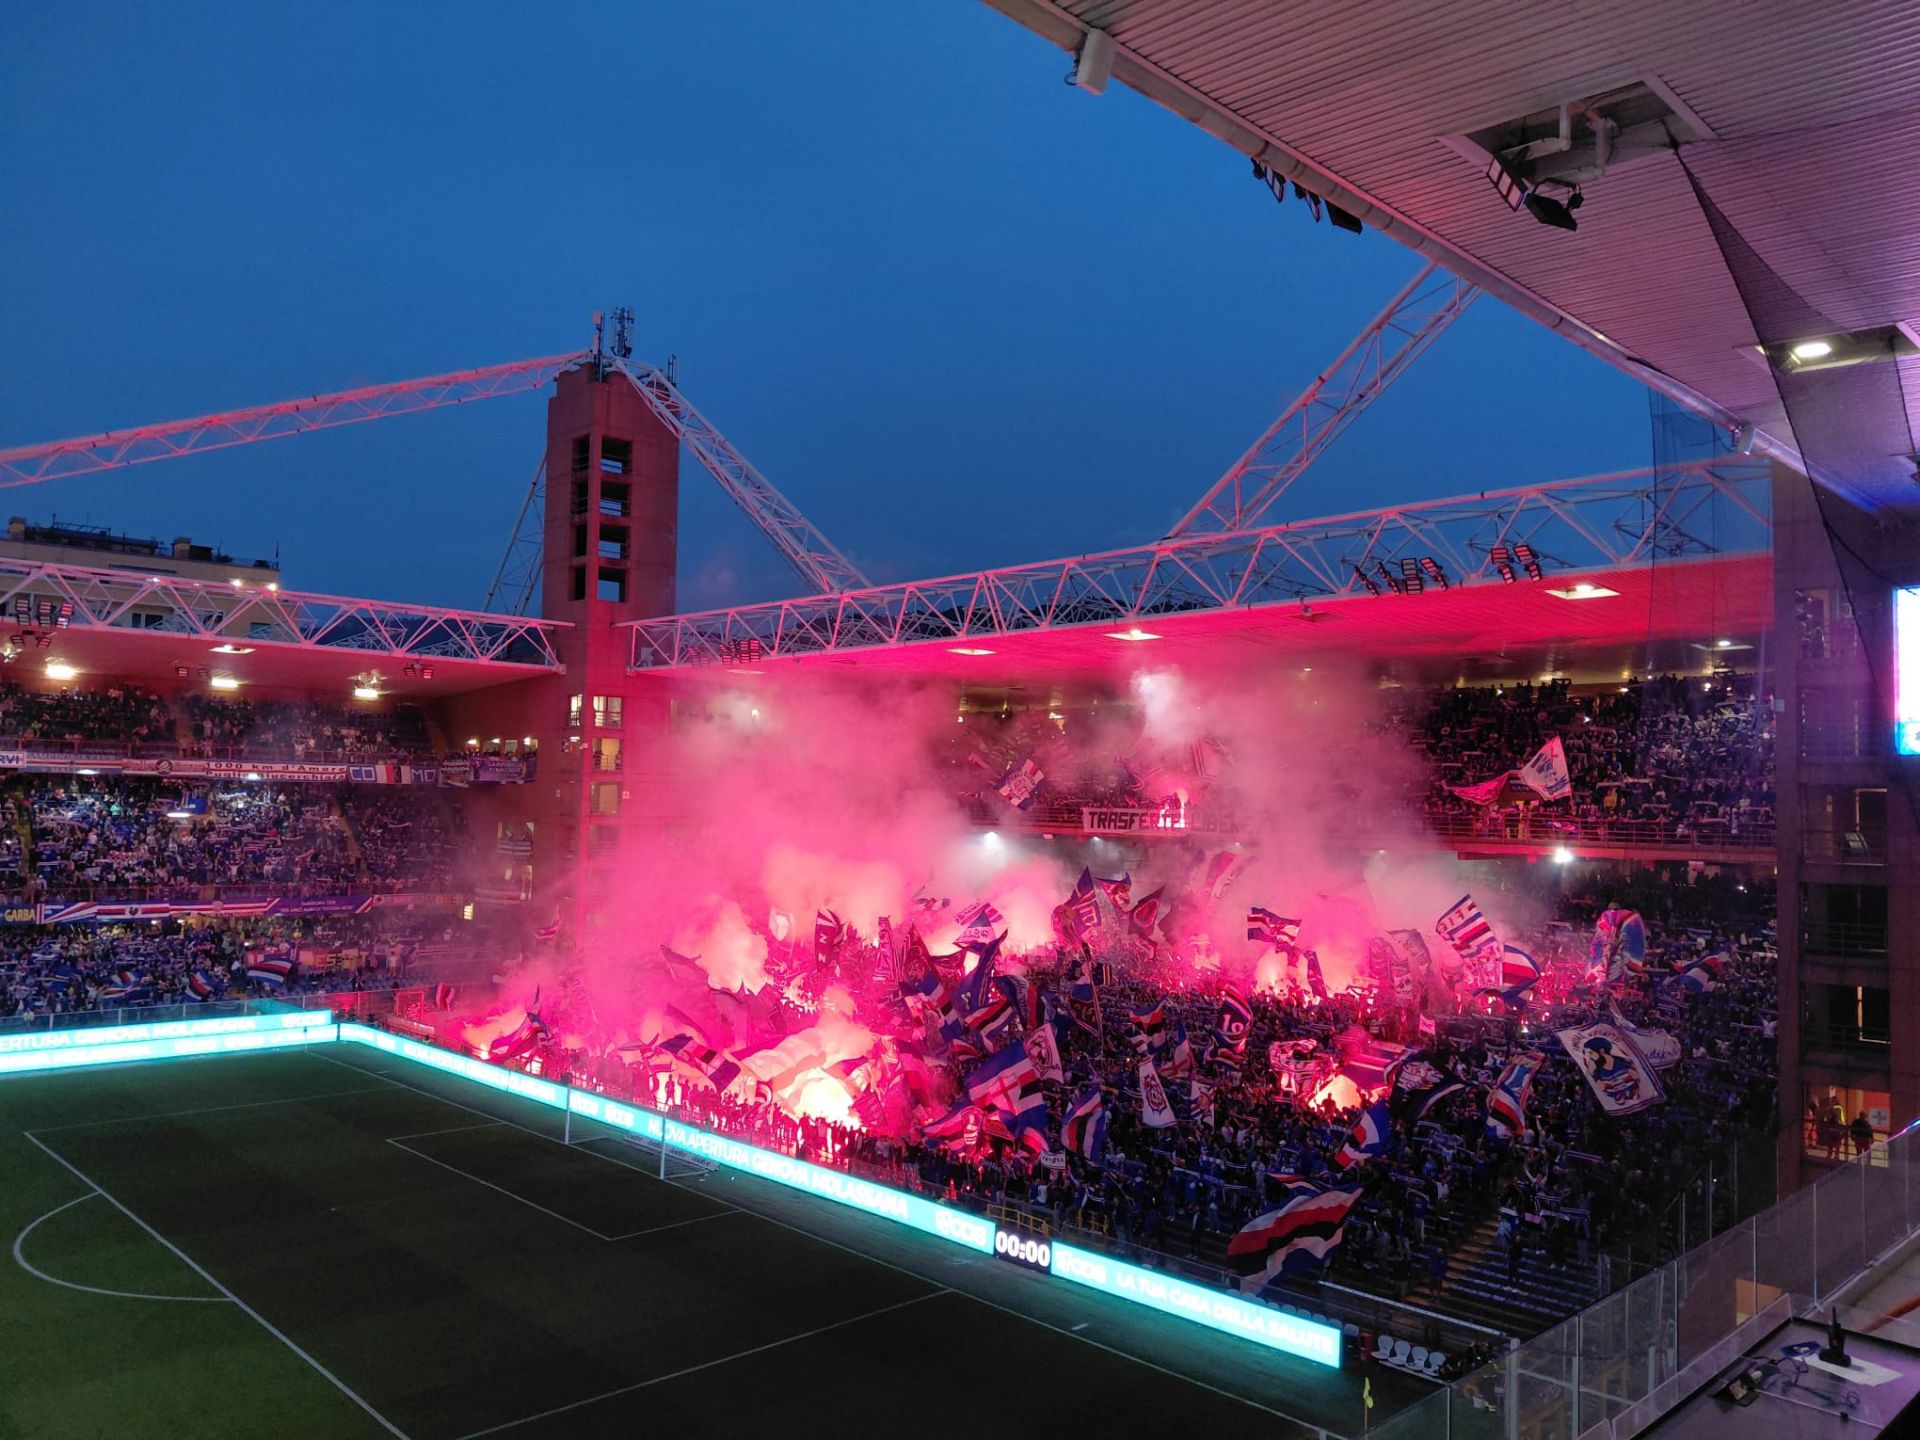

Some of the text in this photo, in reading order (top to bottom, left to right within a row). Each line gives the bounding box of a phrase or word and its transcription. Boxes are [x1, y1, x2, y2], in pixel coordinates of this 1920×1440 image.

[4, 908, 36, 922] GARBA
[686, 1129, 751, 1169] APERTURA
[751, 1151, 809, 1186] GENOVA
[811, 1173, 910, 1219] MOLASSANA
[995, 1230, 1051, 1268] 00:00
[1116, 1270, 1136, 1292] LA
[1136, 1277, 1168, 1303] TUA
[1169, 1286, 1211, 1317] CASA
[1212, 1300, 1266, 1335] DELLA
[1265, 1316, 1335, 1356] SALUTE
